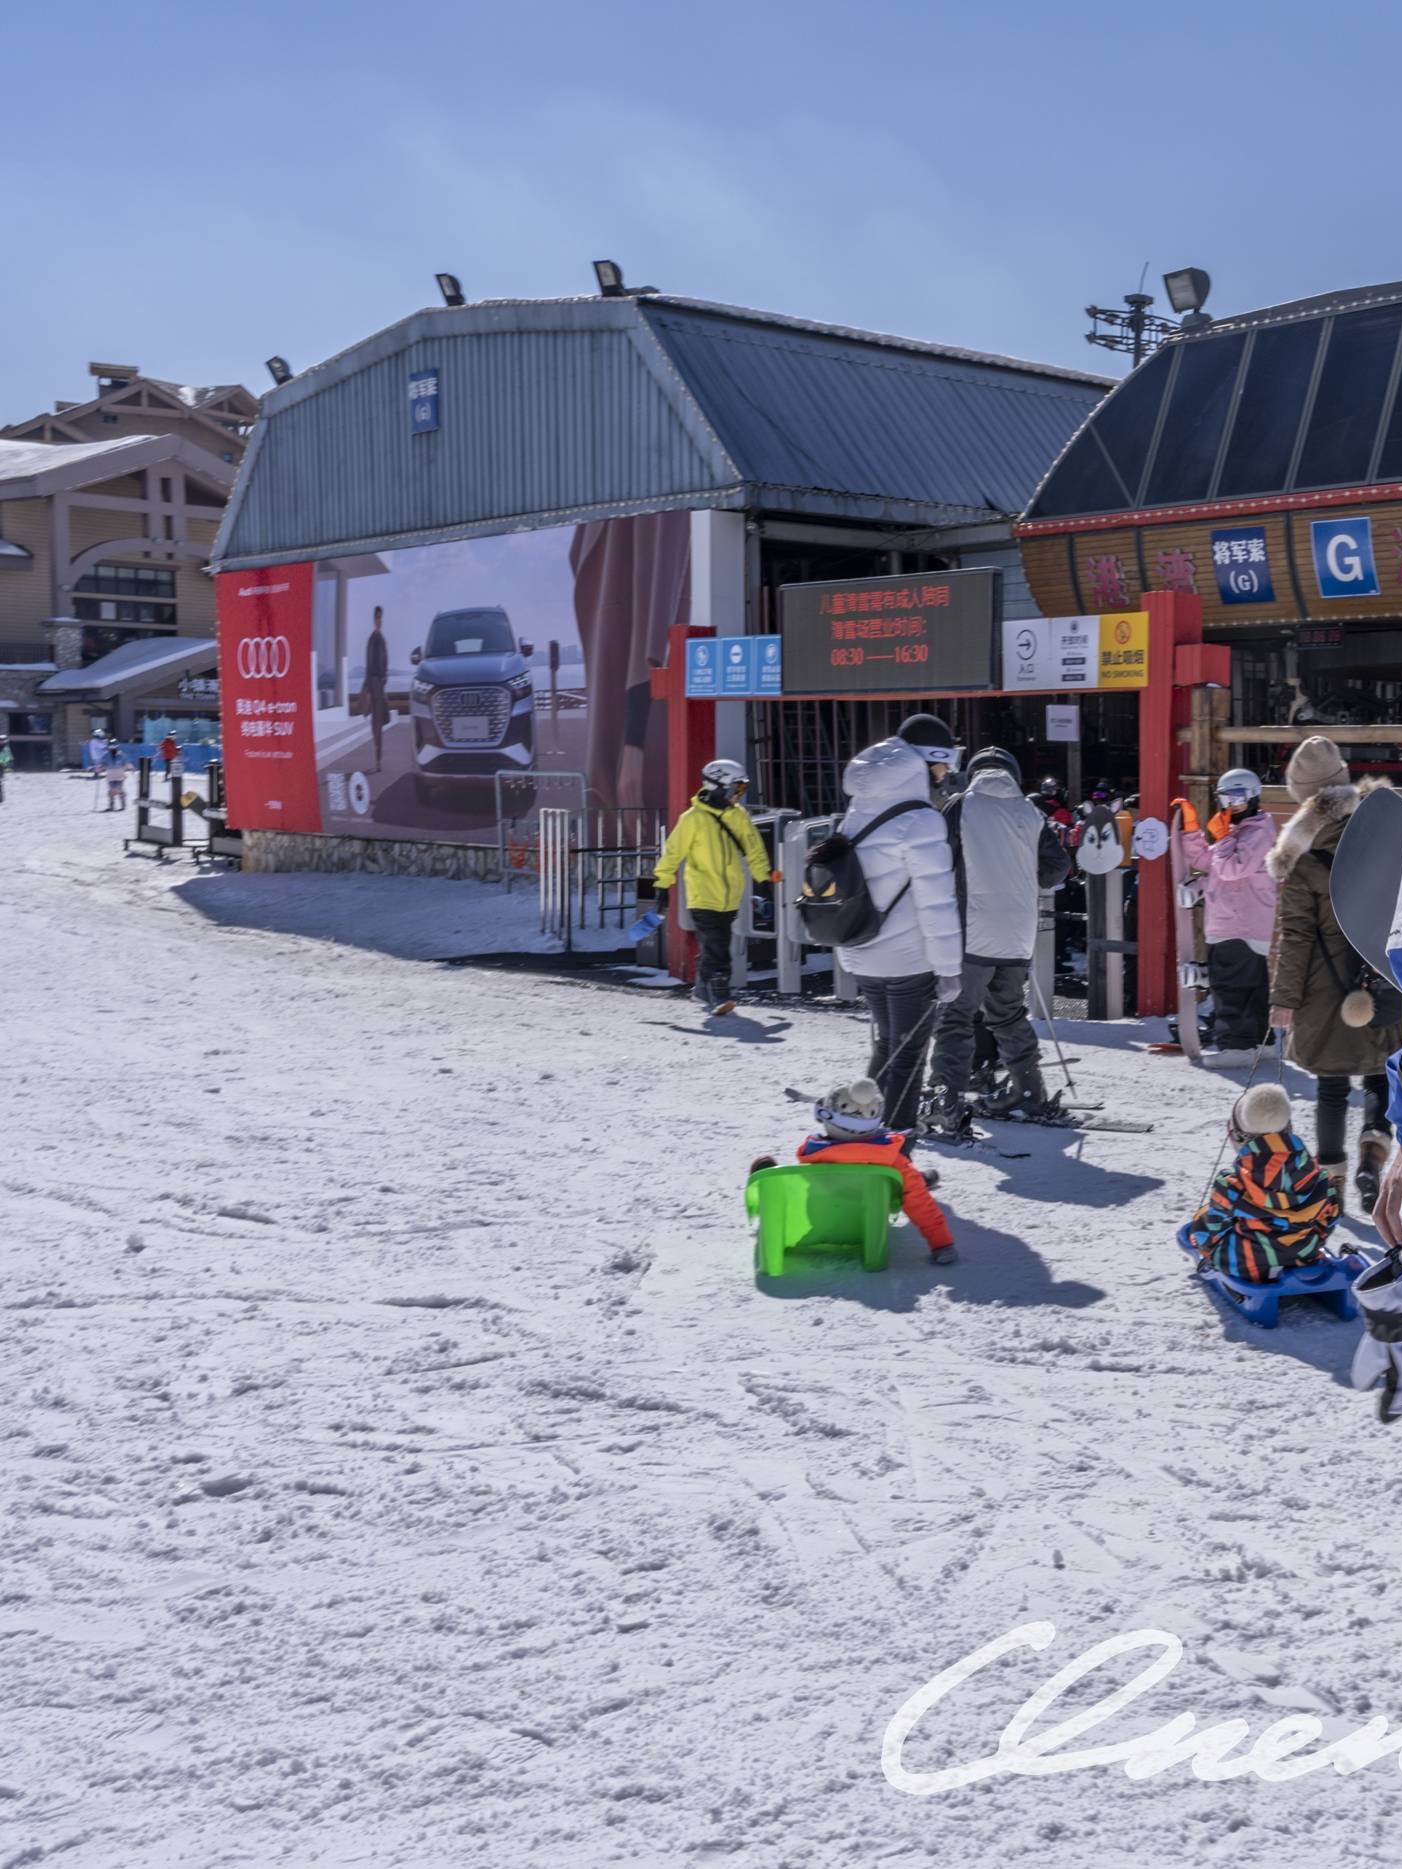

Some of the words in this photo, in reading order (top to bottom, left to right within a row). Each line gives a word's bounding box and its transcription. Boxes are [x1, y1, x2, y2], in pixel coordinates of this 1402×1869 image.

[1212, 538, 1266, 565] 将军索
[1326, 533, 1364, 582] G
[1229, 569, 1259, 594] (G)
[1101, 649, 1144, 666] 禁止吸烟
